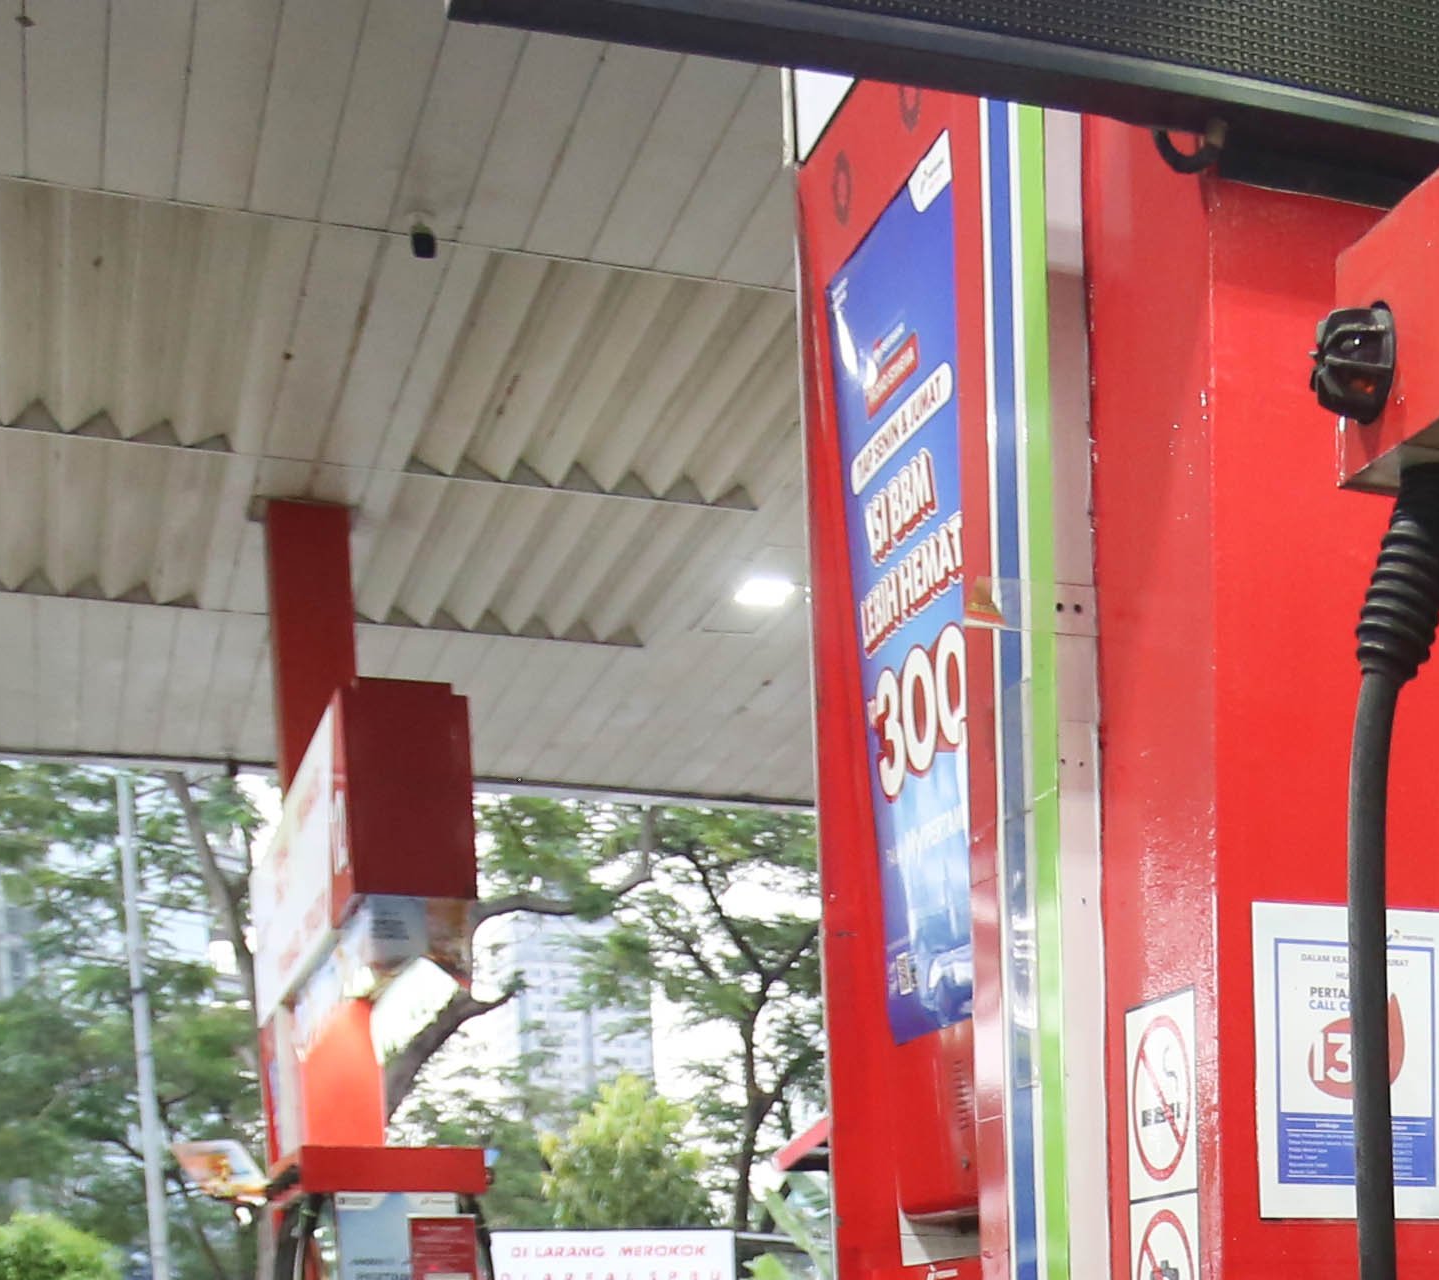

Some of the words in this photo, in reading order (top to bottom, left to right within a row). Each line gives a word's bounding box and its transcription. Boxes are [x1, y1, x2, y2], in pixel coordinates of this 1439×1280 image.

[889, 448, 938, 545] BBM
[861, 565, 901, 652] LEBIH
[899, 510, 963, 618] HEMAT
[875, 622, 967, 798] 300
[1309, 1000, 1336, 1011] CALL
[1310, 987, 1351, 1000] PERTA
[535, 1246, 605, 1257] LARANG
[618, 1245, 706, 1256] MEROKOK
